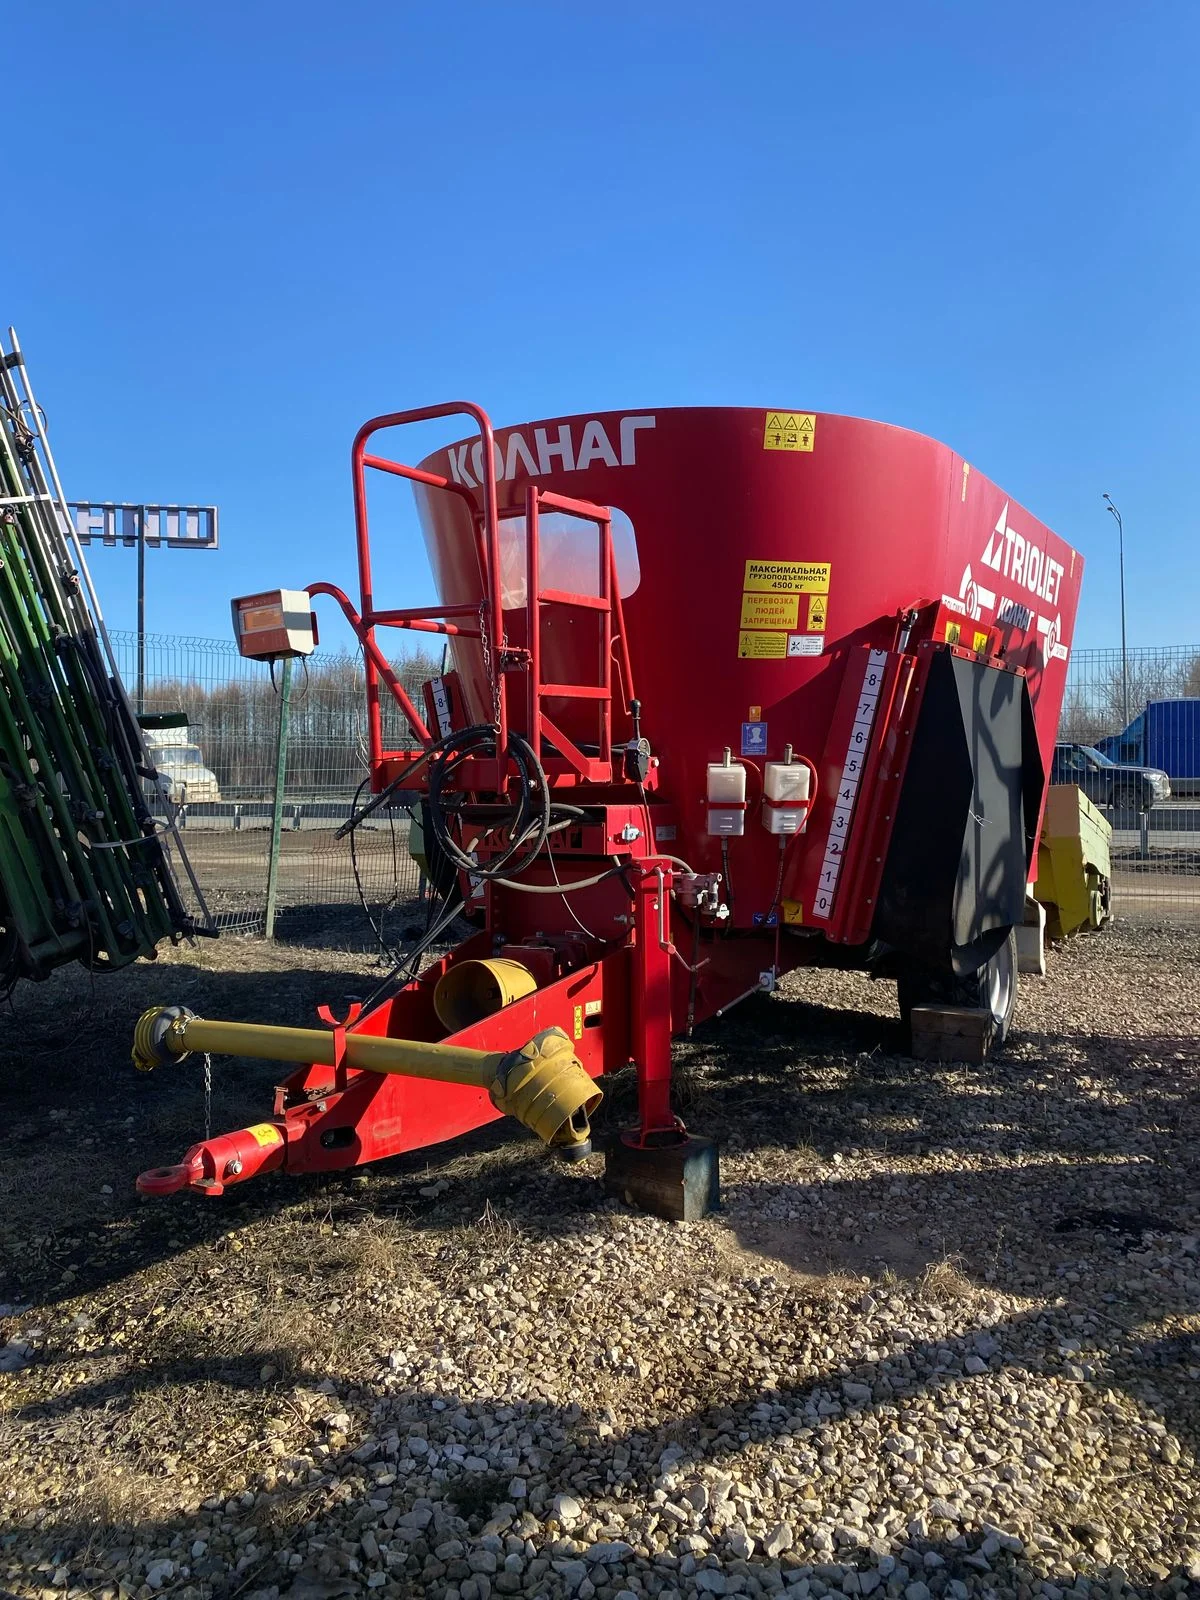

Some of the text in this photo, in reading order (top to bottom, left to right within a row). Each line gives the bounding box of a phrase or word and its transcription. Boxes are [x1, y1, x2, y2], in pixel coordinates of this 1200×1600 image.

[447, 415, 656, 489] КОЛНАГ
[749, 565, 828, 575] МАКСИМАЛЬНАЯ
[1003, 526, 1065, 606] TRIOLIET
[749, 573, 826, 582] ГРУЗОПОДЪЕМНОСТЬ
[771, 581, 793, 589] 4500
[747, 597, 794, 605] ПЕРЕВОЗКА
[754, 606, 785, 615] ЛЮДЕЙ
[996, 596, 1035, 632] КОЛНАГ
[743, 617, 795, 626] ЗАПРЕЩЕНА!
[868, 674, 877, 686] 8
[437, 697, 444, 708] 8
[862, 703, 871, 715] 7
[442, 721, 448, 731] 7
[855, 731, 864, 743] 6
[848, 760, 858, 772] 5
[842, 789, 850, 800] 4
[836, 816, 845, 828] 3
[830, 843, 839, 855] 2
[825, 871, 832, 882] 1
[818, 897, 827, 909] 0
